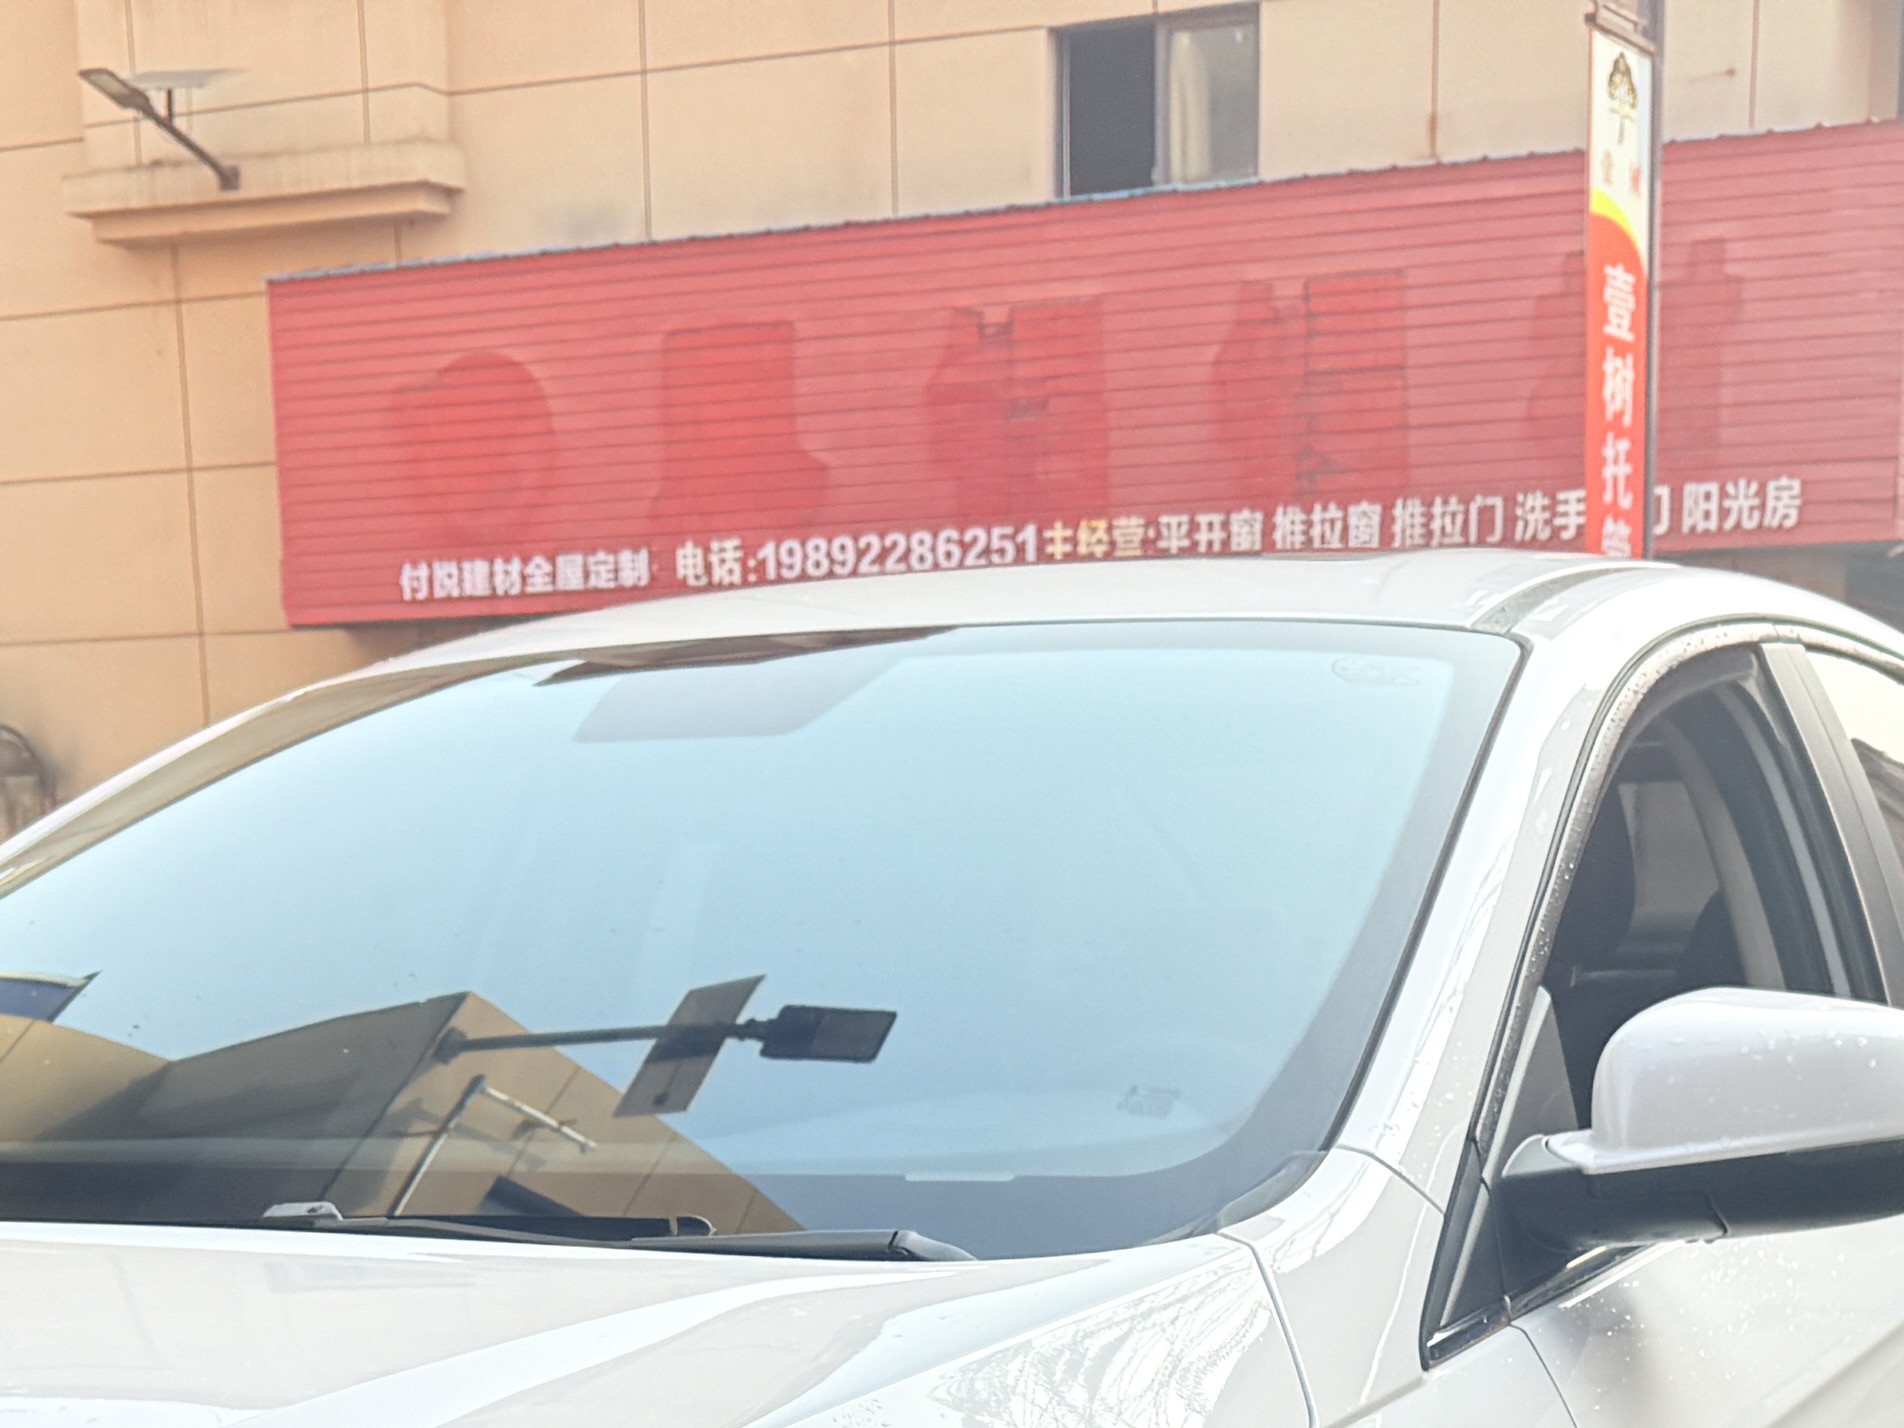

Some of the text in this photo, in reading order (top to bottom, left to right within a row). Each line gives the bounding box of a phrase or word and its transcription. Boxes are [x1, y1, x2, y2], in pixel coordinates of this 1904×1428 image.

[1271, 500, 1383, 550] 推拉窗
[1392, 493, 1505, 548] 推拉门
[1682, 476, 1803, 535] 阳光房
